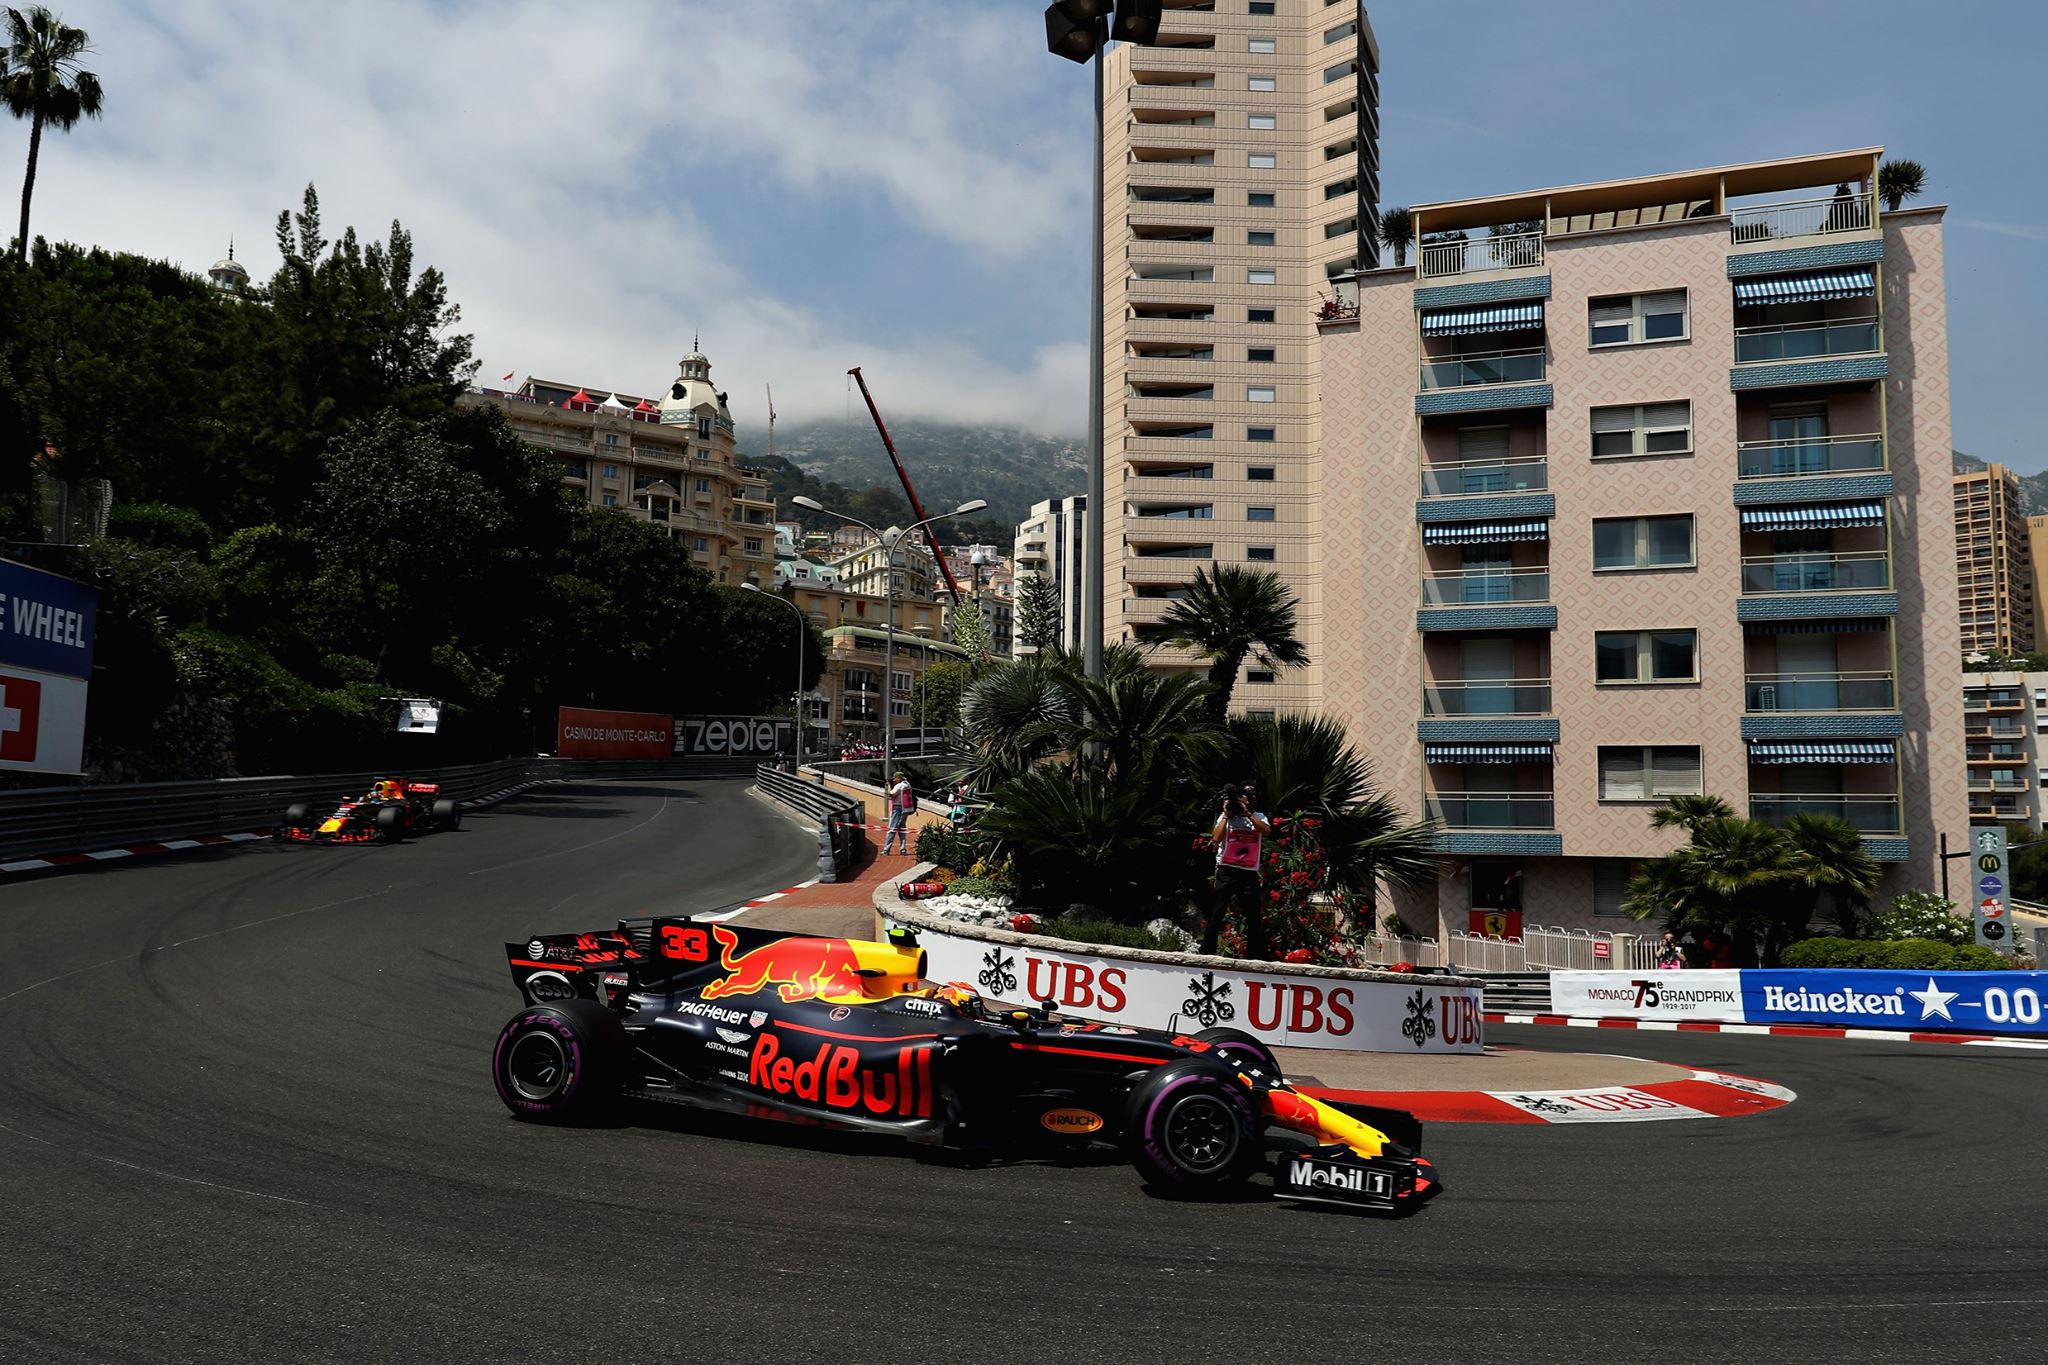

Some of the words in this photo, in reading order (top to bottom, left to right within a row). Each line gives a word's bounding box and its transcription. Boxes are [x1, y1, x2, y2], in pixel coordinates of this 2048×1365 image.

[13, 597, 85, 649] WHEEL
[565, 725, 593, 740] CASINO
[593, 728, 605, 741] DE
[606, 729, 667, 743] MONTE-CARLO
[660, 925, 709, 962] 33
[1025, 957, 1127, 1013] UBS
[1588, 989, 1635, 1001] MONACO
[1245, 981, 1354, 1036] UBS
[1662, 1002, 1697, 1010] 1929-2017
[523, 1014, 574, 1039] ZERO
[1440, 995, 1482, 1045] UBS
[705, 1041, 727, 1053] ASTON
[726, 1046, 750, 1058] MARTIN
[1560, 1091, 1678, 1112] UBS
[1056, 1114, 1095, 1126] RAUCH
[1290, 1161, 1363, 1191] Mobil
[1374, 1175, 1384, 1193] 1
